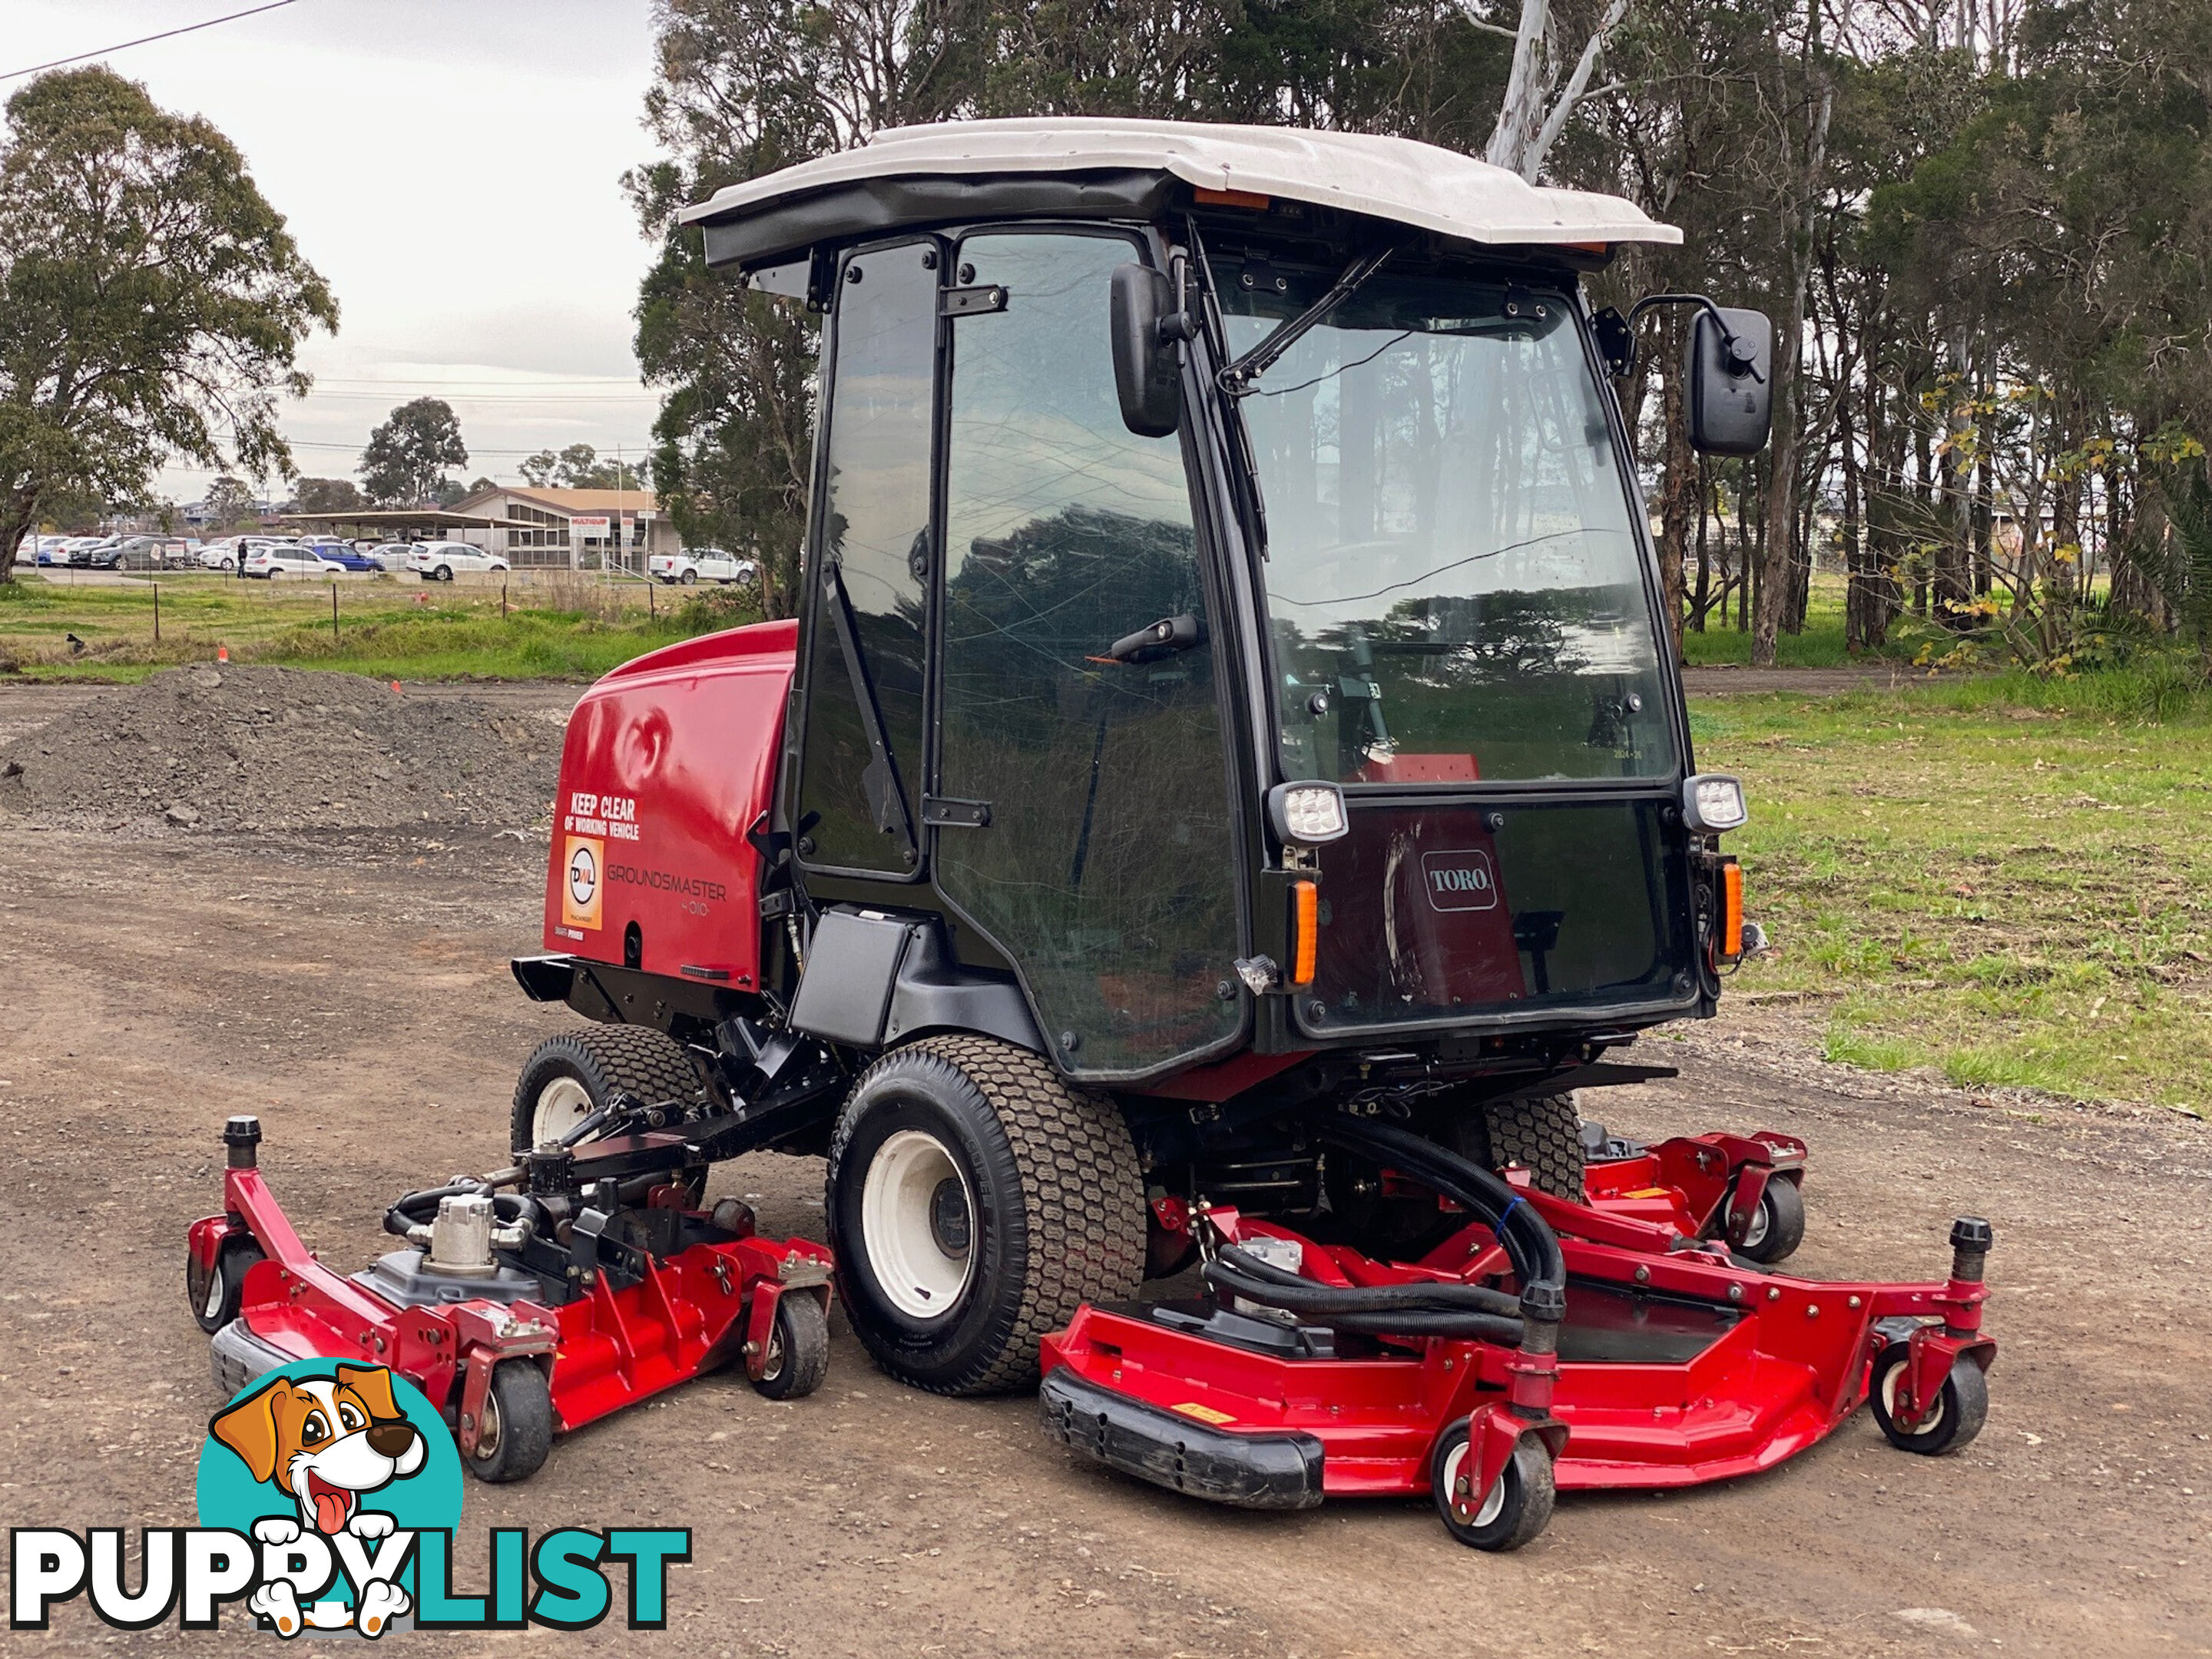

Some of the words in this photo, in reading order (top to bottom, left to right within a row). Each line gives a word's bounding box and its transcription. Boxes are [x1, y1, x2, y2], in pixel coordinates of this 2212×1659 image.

[571, 792, 598, 816] KEEP
[601, 796, 635, 821] CLEAR
[565, 815, 575, 831] OF
[575, 816, 607, 836] WORKING
[609, 821, 639, 841] VEHICLE
[607, 864, 727, 902] GROUNDSMASTER
[1430, 868, 1488, 892] TORO
